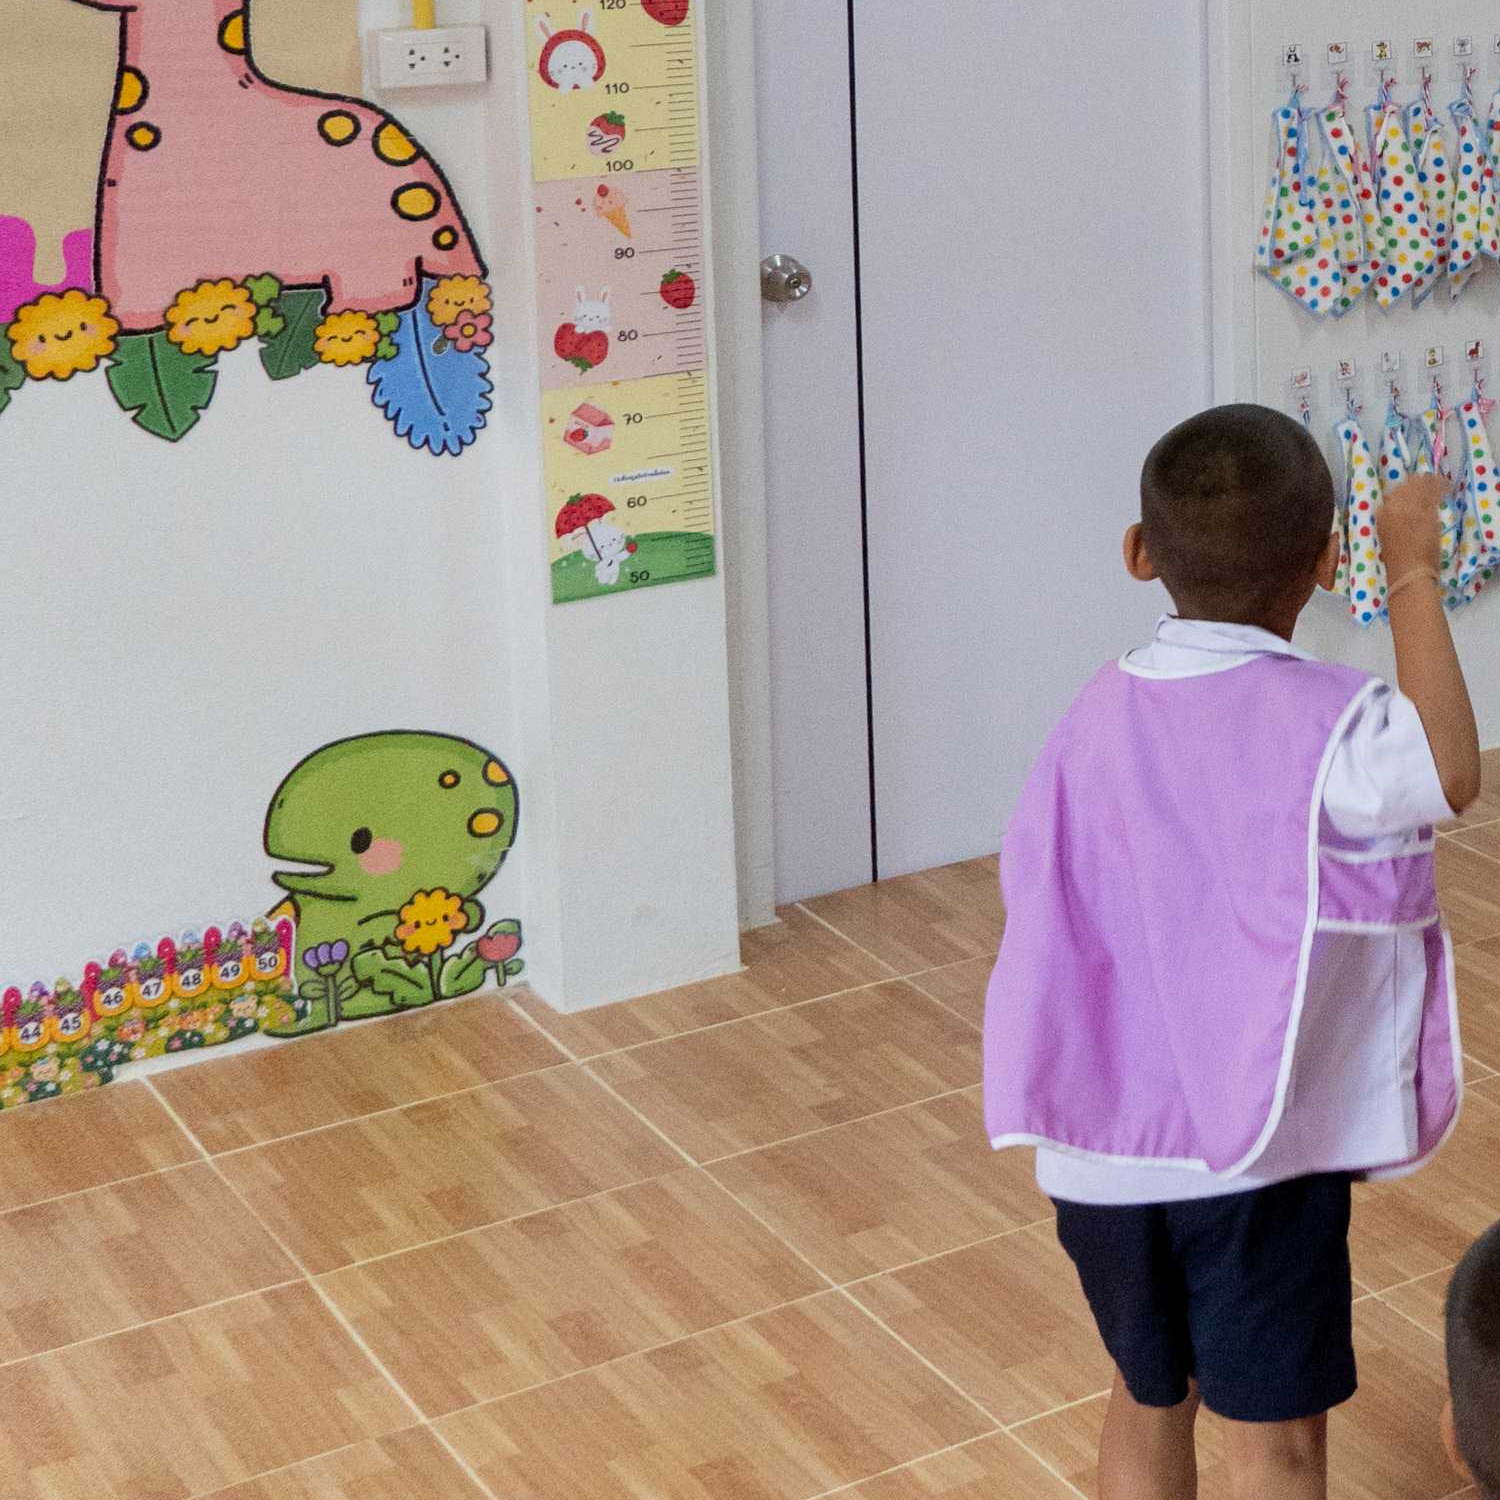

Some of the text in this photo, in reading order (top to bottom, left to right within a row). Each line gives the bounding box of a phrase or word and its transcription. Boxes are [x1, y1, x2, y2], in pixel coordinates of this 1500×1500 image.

[604, 82, 630, 95] 110
[605, 158, 634, 173] 100
[613, 246, 635, 260] 90
[617, 329, 639, 342] 80
[623, 412, 643, 425] 70
[626, 495, 647, 509] 60
[630, 569, 650, 584] 50
[257, 954, 278, 970] 50
[219, 963, 241, 980] 49
[181, 971, 202, 988] 48
[142, 980, 162, 997] 47
[103, 990, 124, 1005] 46
[60, 1014, 81, 1032] 45
[20, 1021, 41, 1041] 44
